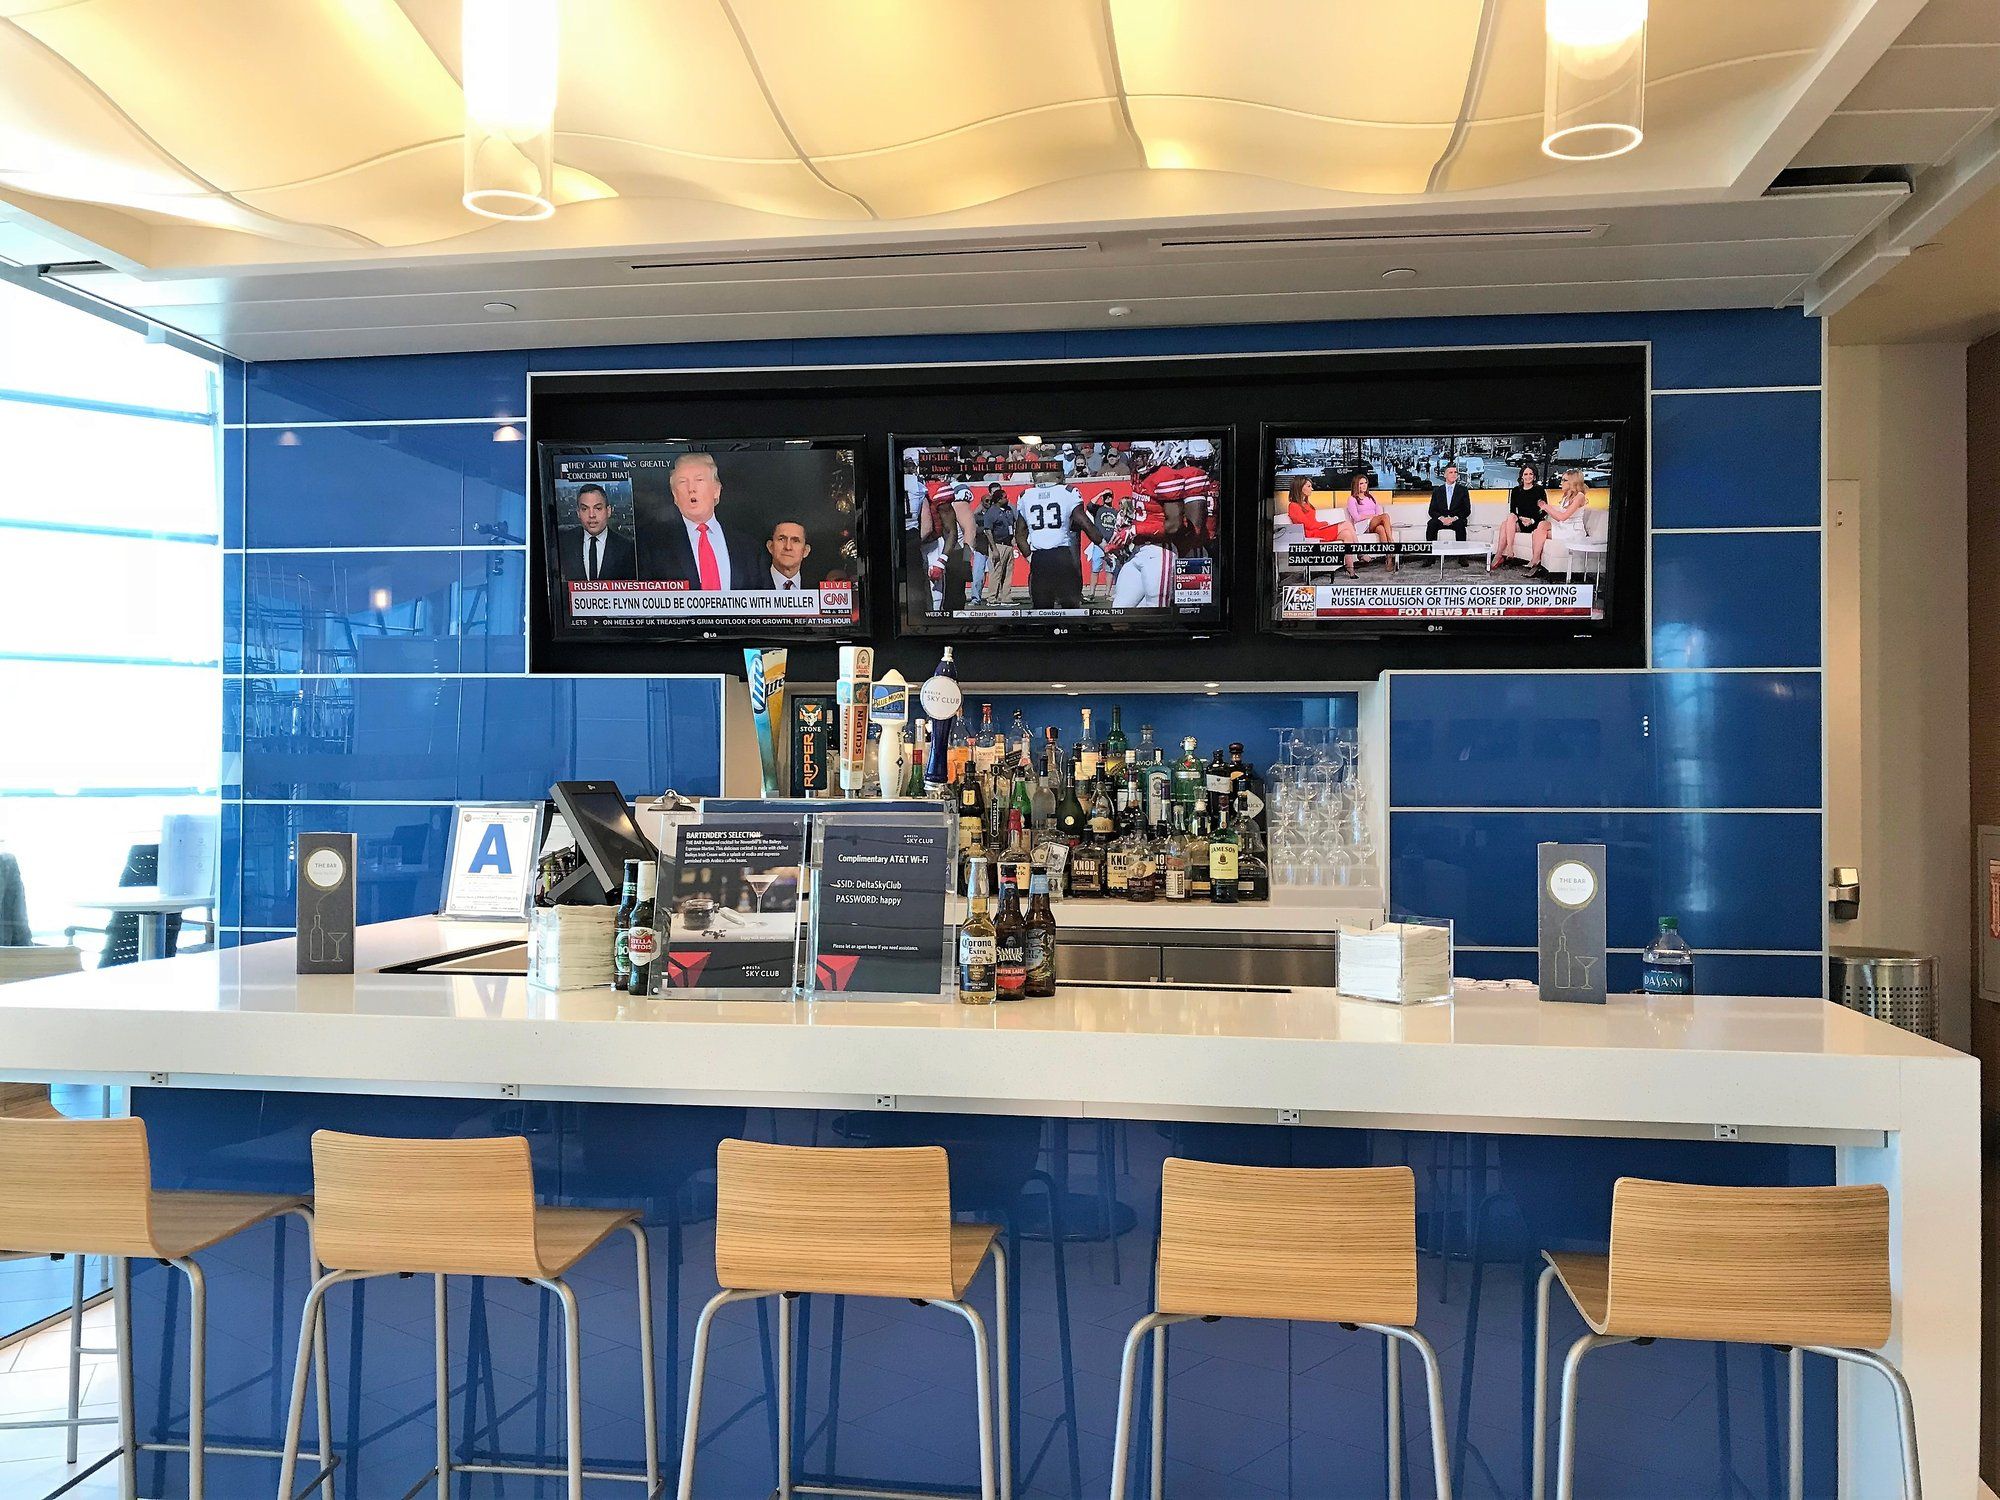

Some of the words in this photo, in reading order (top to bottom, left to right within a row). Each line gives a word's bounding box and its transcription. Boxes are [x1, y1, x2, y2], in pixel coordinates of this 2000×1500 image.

[640, 460, 671, 468] GREATLY
[612, 471, 629, 479] THAT
[1030, 502, 1062, 530] 33
[1289, 545, 1313, 553] THEY
[1352, 544, 1395, 552] TALKING
[1401, 543, 1432, 551] ABOUT
[1289, 556, 1343, 564] SANCTION.
[573, 582, 609, 590] RUSSIA
[612, 581, 684, 590] INVESTIGATION
[1332, 587, 1378, 596] WHETHER
[1381, 587, 1422, 596] MUELLER
[1426, 587, 1467, 596] GETTING
[1470, 587, 1506, 595] CLOSER
[1510, 587, 1523, 595] TO
[1526, 587, 1577, 595] SHOWING
[823, 593, 848, 605] CNN
[1293, 593, 1314, 602] FOX
[1331, 597, 1365, 606] RUSSIA
[1368, 597, 1424, 606] COLLUSION
[1427, 597, 1441, 605] OR
[1444, 597, 1465, 605] THIS
[1468, 597, 1496, 605] MORE
[1499, 597, 1524, 606] DRIP,
[1527, 597, 1552, 606] DRIP,
[1555, 597, 1577, 605] DRIP
[574, 598, 611, 610] SOURCE:
[613, 598, 640, 609] FLYNN
[642, 598, 671, 609] COULD
[673, 598, 685, 609] BE
[687, 597, 747, 609] COOPERATING
[749, 597, 772, 608] WITH
[773, 596, 814, 608] MUELLER
[1288, 602, 1314, 611] NEWS
[1398, 608, 1424, 616] FOX
[1427, 608, 1463, 616] NEWS
[1466, 608, 1506, 616] ALERT
[855, 710, 864, 754] SCULPIN
[804, 733, 818, 787] RIPPER
[468, 824, 512, 874] A
[838, 854, 888, 864] Complimentary
[889, 855, 909, 863] AT&T
[910, 855, 928, 863] Wi-Fi
[1073, 860, 1095, 870] KNOB
[836, 880, 855, 888] SSID:
[856, 880, 902, 890] DeltaSkyClub
[835, 894, 879, 904] PASSWORD:
[880, 895, 902, 906] happy
[962, 938, 992, 948] Corona
[996, 946, 1024, 956] SAMUEL
[998, 953, 1022, 962] ADAMS
[1644, 974, 1682, 988] DASANI
